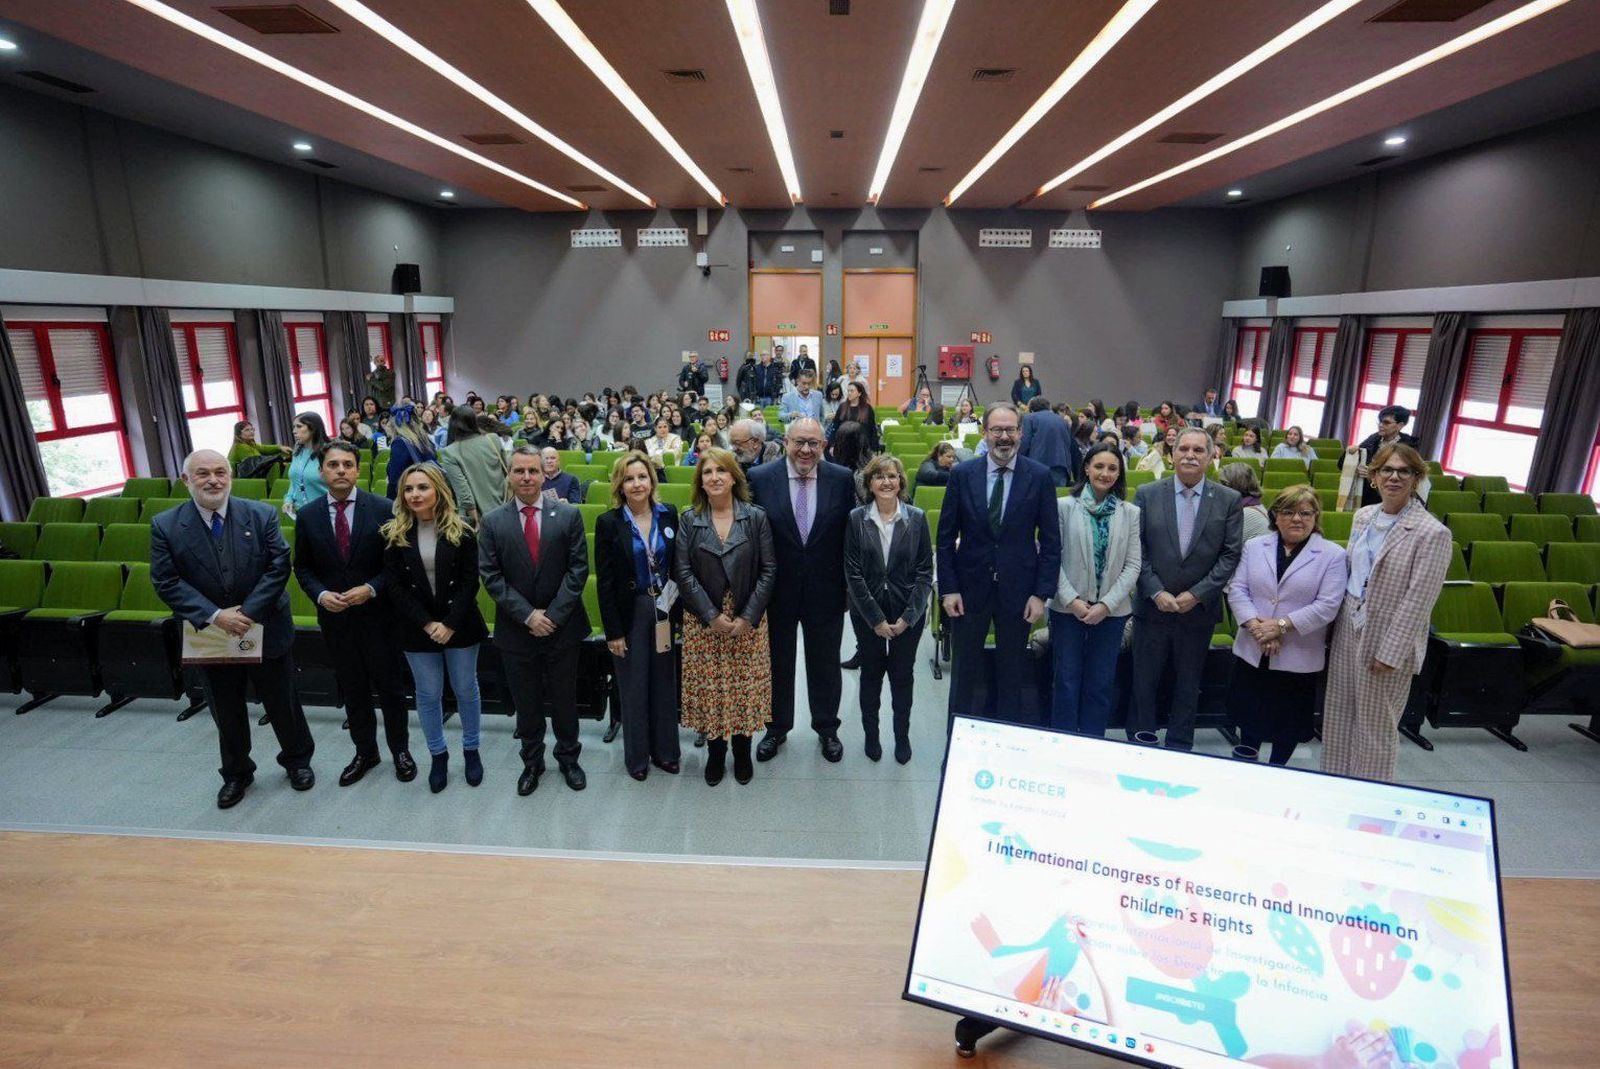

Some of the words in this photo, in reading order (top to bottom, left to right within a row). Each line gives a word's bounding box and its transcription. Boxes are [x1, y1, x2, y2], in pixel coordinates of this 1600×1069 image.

[1008, 778, 1066, 799] CRECER
[987, 840, 993, 853] I
[996, 842, 1089, 873] International
[1092, 862, 1160, 888] Congress
[1165, 878, 1181, 891] of
[1185, 880, 1257, 907] Research
[1262, 898, 1293, 915] and
[1298, 903, 1392, 936] Innovation
[1396, 926, 1419, 942] on
[1202, 912, 1254, 936] Rights
